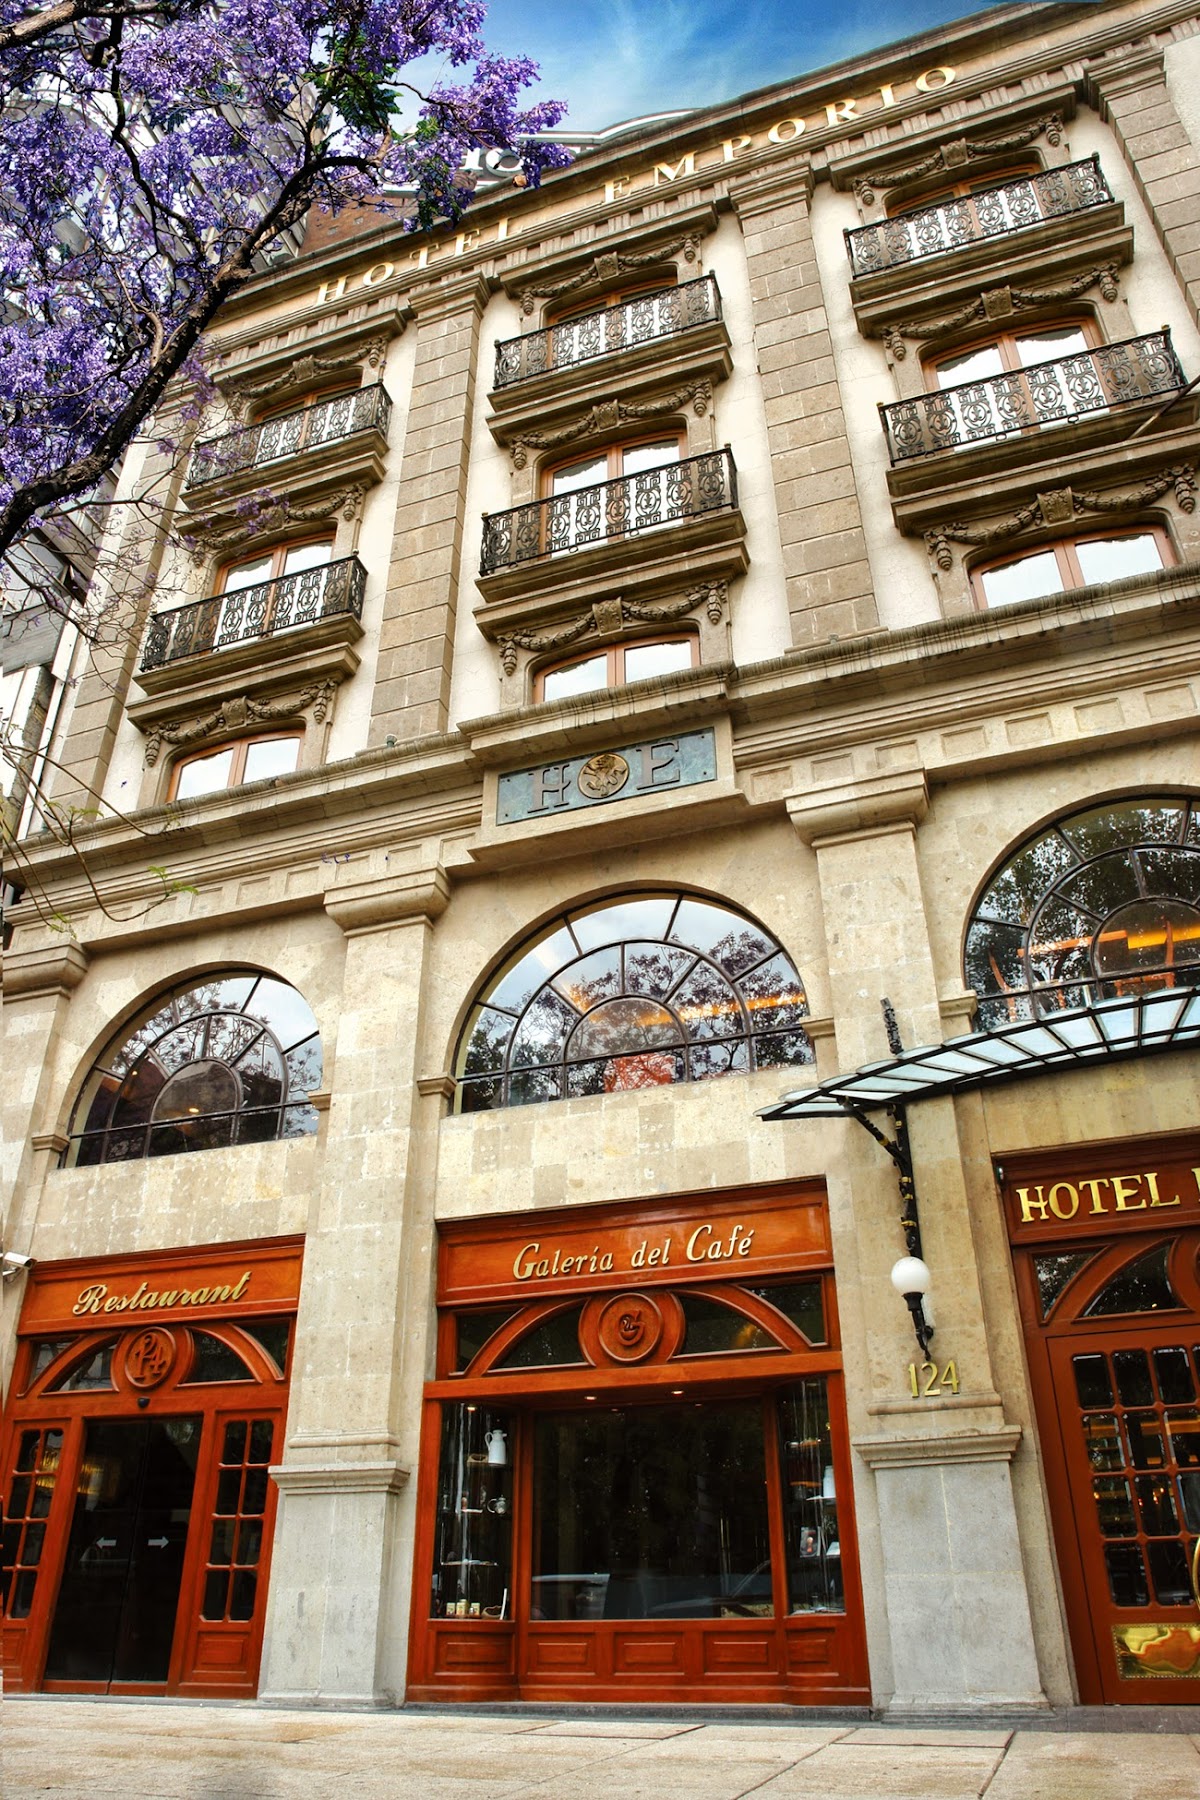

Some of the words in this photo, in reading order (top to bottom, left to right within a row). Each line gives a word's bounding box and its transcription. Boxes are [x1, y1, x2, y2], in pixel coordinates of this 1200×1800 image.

[313, 217, 525, 307] HOTEL
[601, 66, 957, 204] EMPORIO
[1016, 1173, 1181, 1223] HOTEL
[512, 1243, 613, 1280] Galería
[630, 1239, 671, 1268] del
[686, 1224, 755, 1261] Café
[72, 1271, 252, 1316] Restaurant
[908, 1360, 960, 1398] 124
